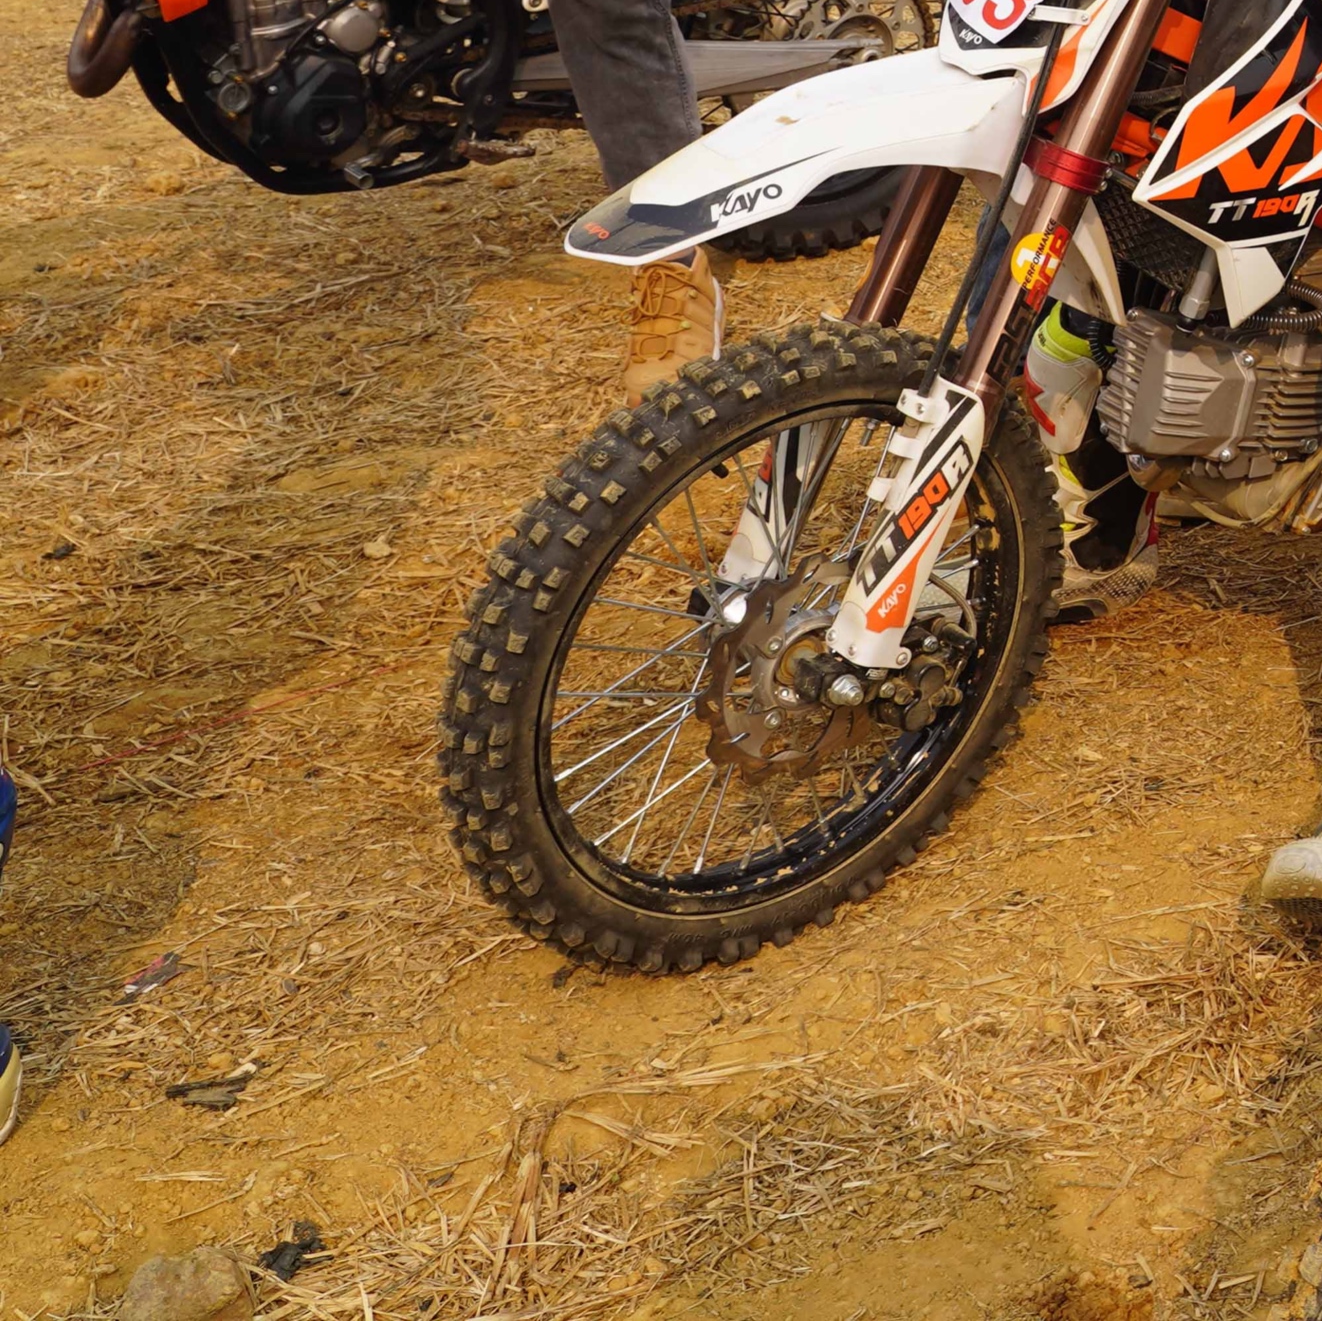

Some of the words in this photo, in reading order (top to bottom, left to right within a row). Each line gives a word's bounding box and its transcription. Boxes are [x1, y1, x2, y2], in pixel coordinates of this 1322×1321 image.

[959, 28, 982, 46] KAYO
[709, 183, 783, 223] KAYO
[1207, 188, 1320, 227] TT190R
[1021, 217, 1058, 291] PERFORMANCE
[863, 444, 971, 588] TT190R
[877, 582, 907, 619] KAYO
